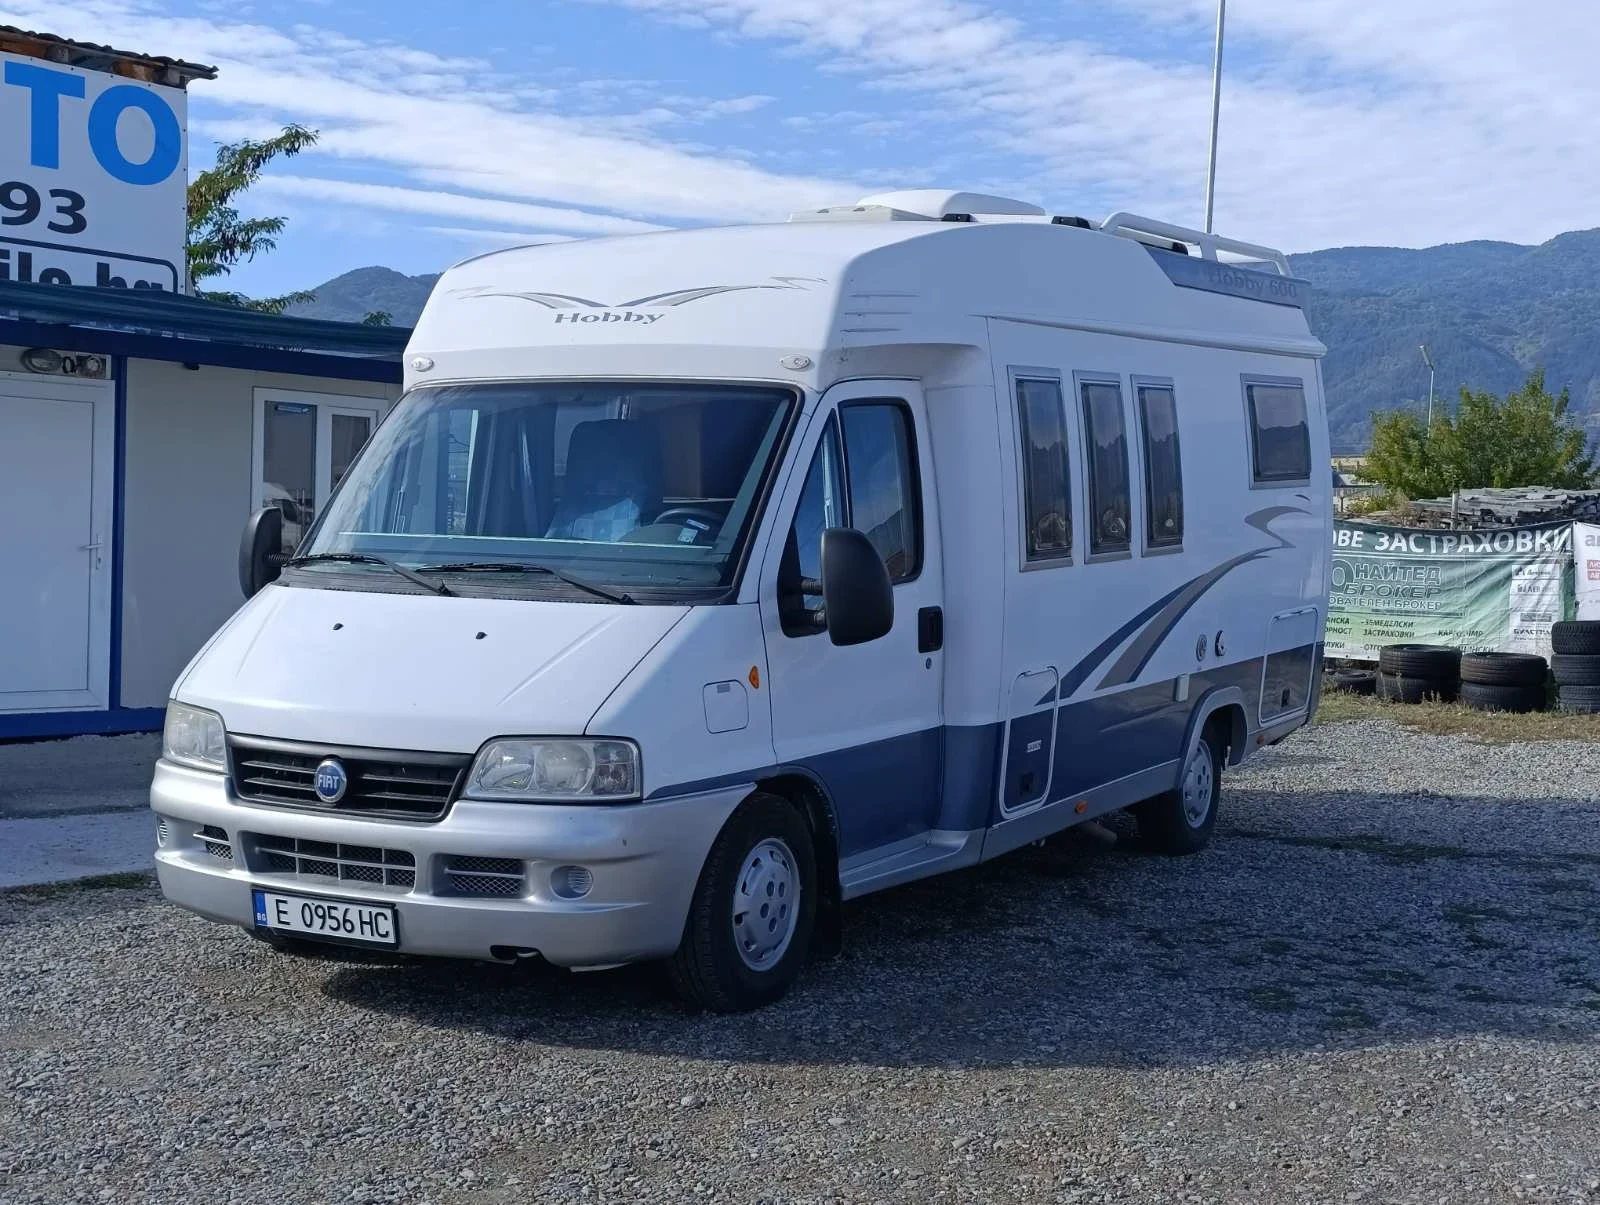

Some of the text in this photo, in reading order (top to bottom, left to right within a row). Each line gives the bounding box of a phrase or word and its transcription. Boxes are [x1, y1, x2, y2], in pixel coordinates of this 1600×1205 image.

[0, 181, 87, 235] 93
[1209, 269, 1297, 298] Hobby 600
[554, 311, 665, 325] Hobby
[1332, 527, 1572, 554] ВЕ ЗАСТРАХОВКИ
[1343, 583, 1441, 599] БРОКЕР
[1363, 629, 1415, 638] ЗАСТРАХОВКИ
[318, 774, 339, 789] FIAT
[256, 912, 267, 922] BG
[275, 899, 291, 926] E
